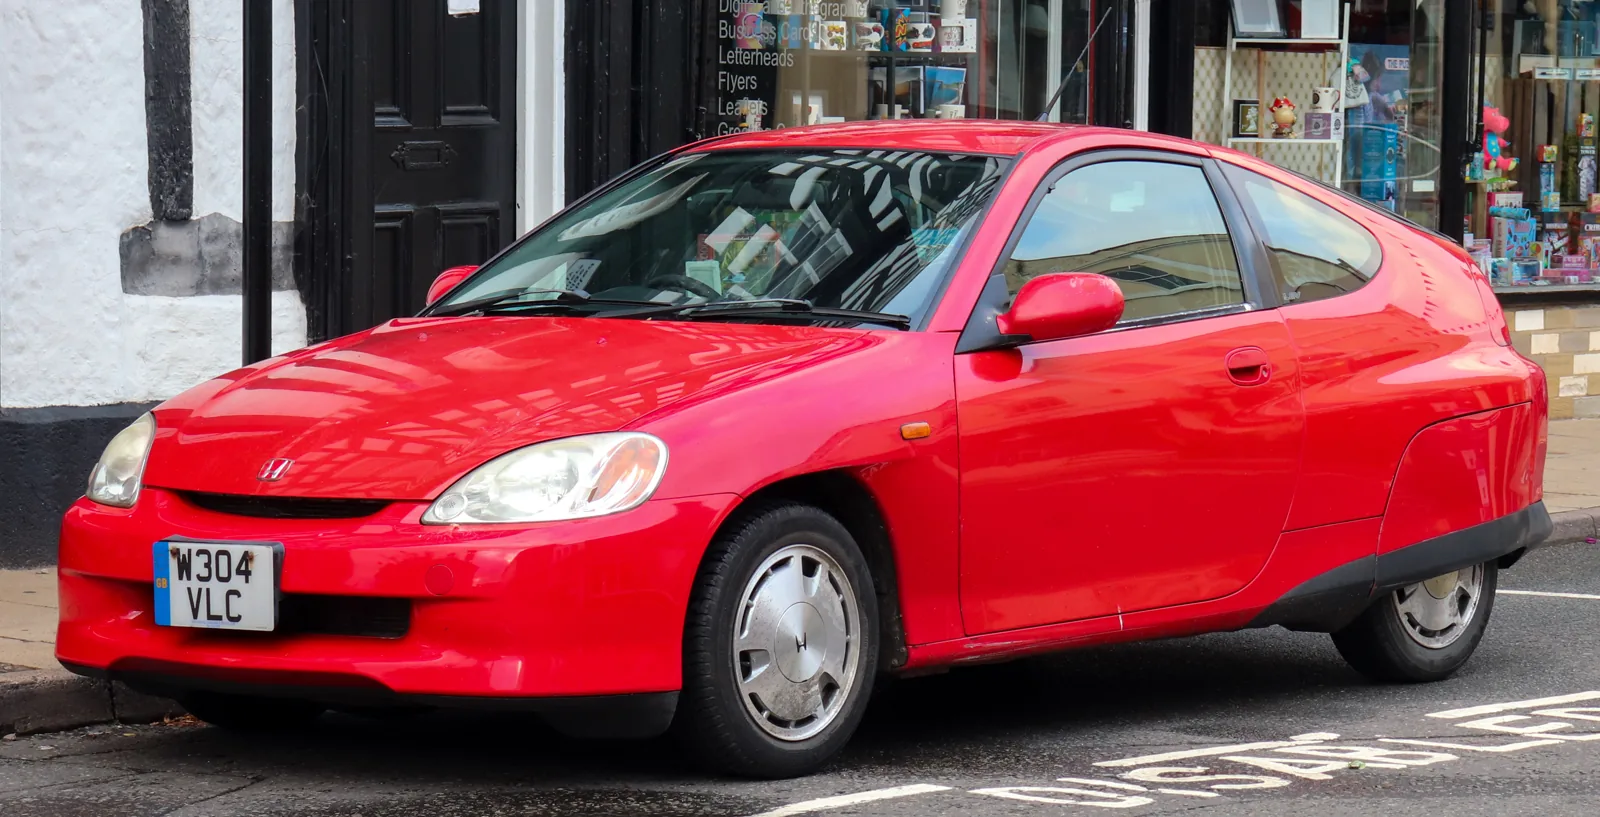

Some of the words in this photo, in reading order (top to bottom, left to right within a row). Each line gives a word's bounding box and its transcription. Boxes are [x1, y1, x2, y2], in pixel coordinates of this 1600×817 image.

[788, 0, 867, 20] thographic
[719, 45, 794, 67] Letterheads
[718, 71, 758, 94] Flyers
[718, 96, 768, 116] Leaflets
[717, 121, 772, 138] Gree
[176, 548, 252, 584] W304
[156, 577, 168, 589] GB
[187, 587, 242, 623] VLC
